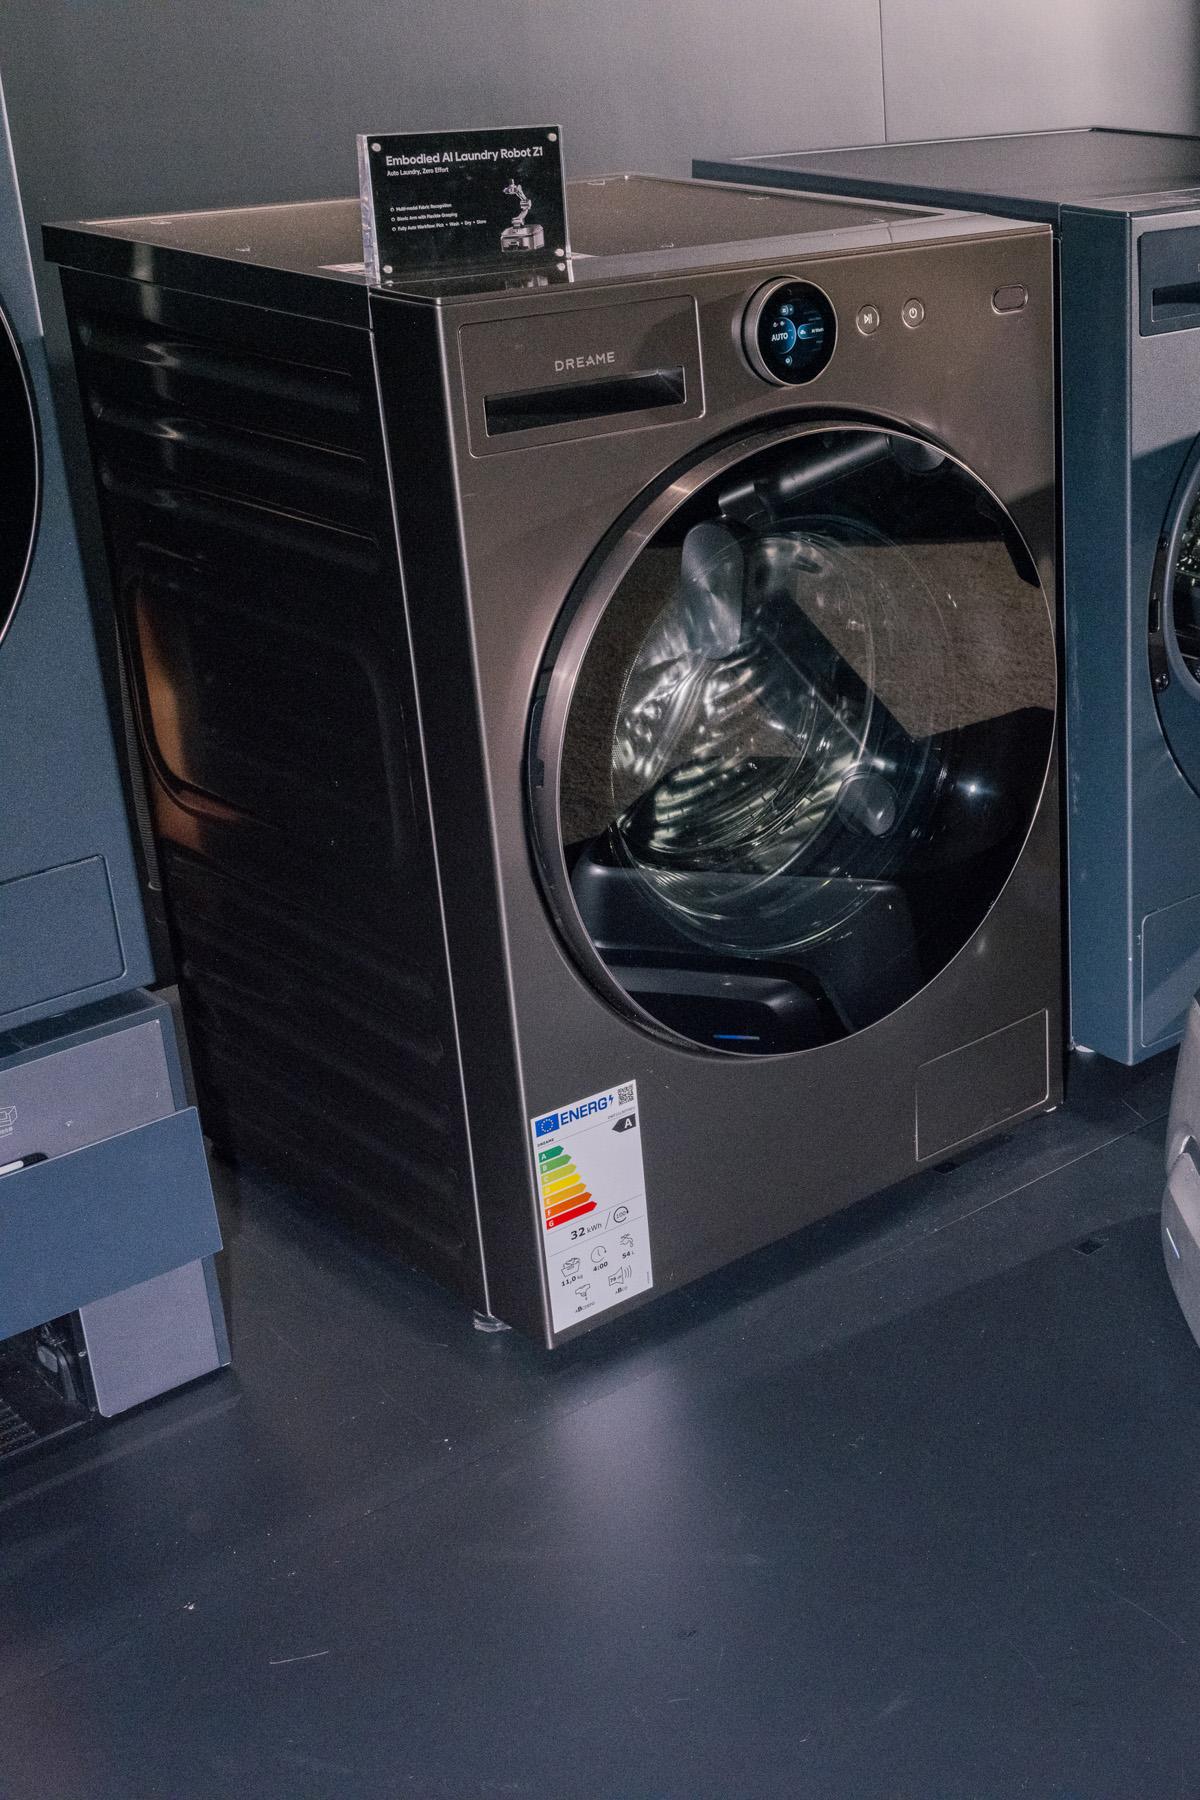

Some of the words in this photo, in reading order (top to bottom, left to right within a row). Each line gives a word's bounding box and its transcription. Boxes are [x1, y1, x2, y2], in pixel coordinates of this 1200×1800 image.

[385, 153, 440, 166] Embodied
[442, 152, 453, 162] AI
[455, 149, 499, 162] Laundry
[500, 147, 532, 159] Robot
[532, 146, 543, 157] Z1
[400, 168, 422, 176] Laundry,
[771, 332, 789, 342] AUTO
[554, 351, 616, 372] DREAME
[560, 1096, 608, 1126] ENERG
[624, 1118, 633, 1129] A
[616, 1211, 627, 1219] 100
[570, 1227, 586, 1240] 32
[586, 1223, 602, 1234] kWh
[622, 1251, 631, 1260] 54
[593, 1261, 609, 1272] 4:00
[561, 1275, 577, 1287] 11,0
